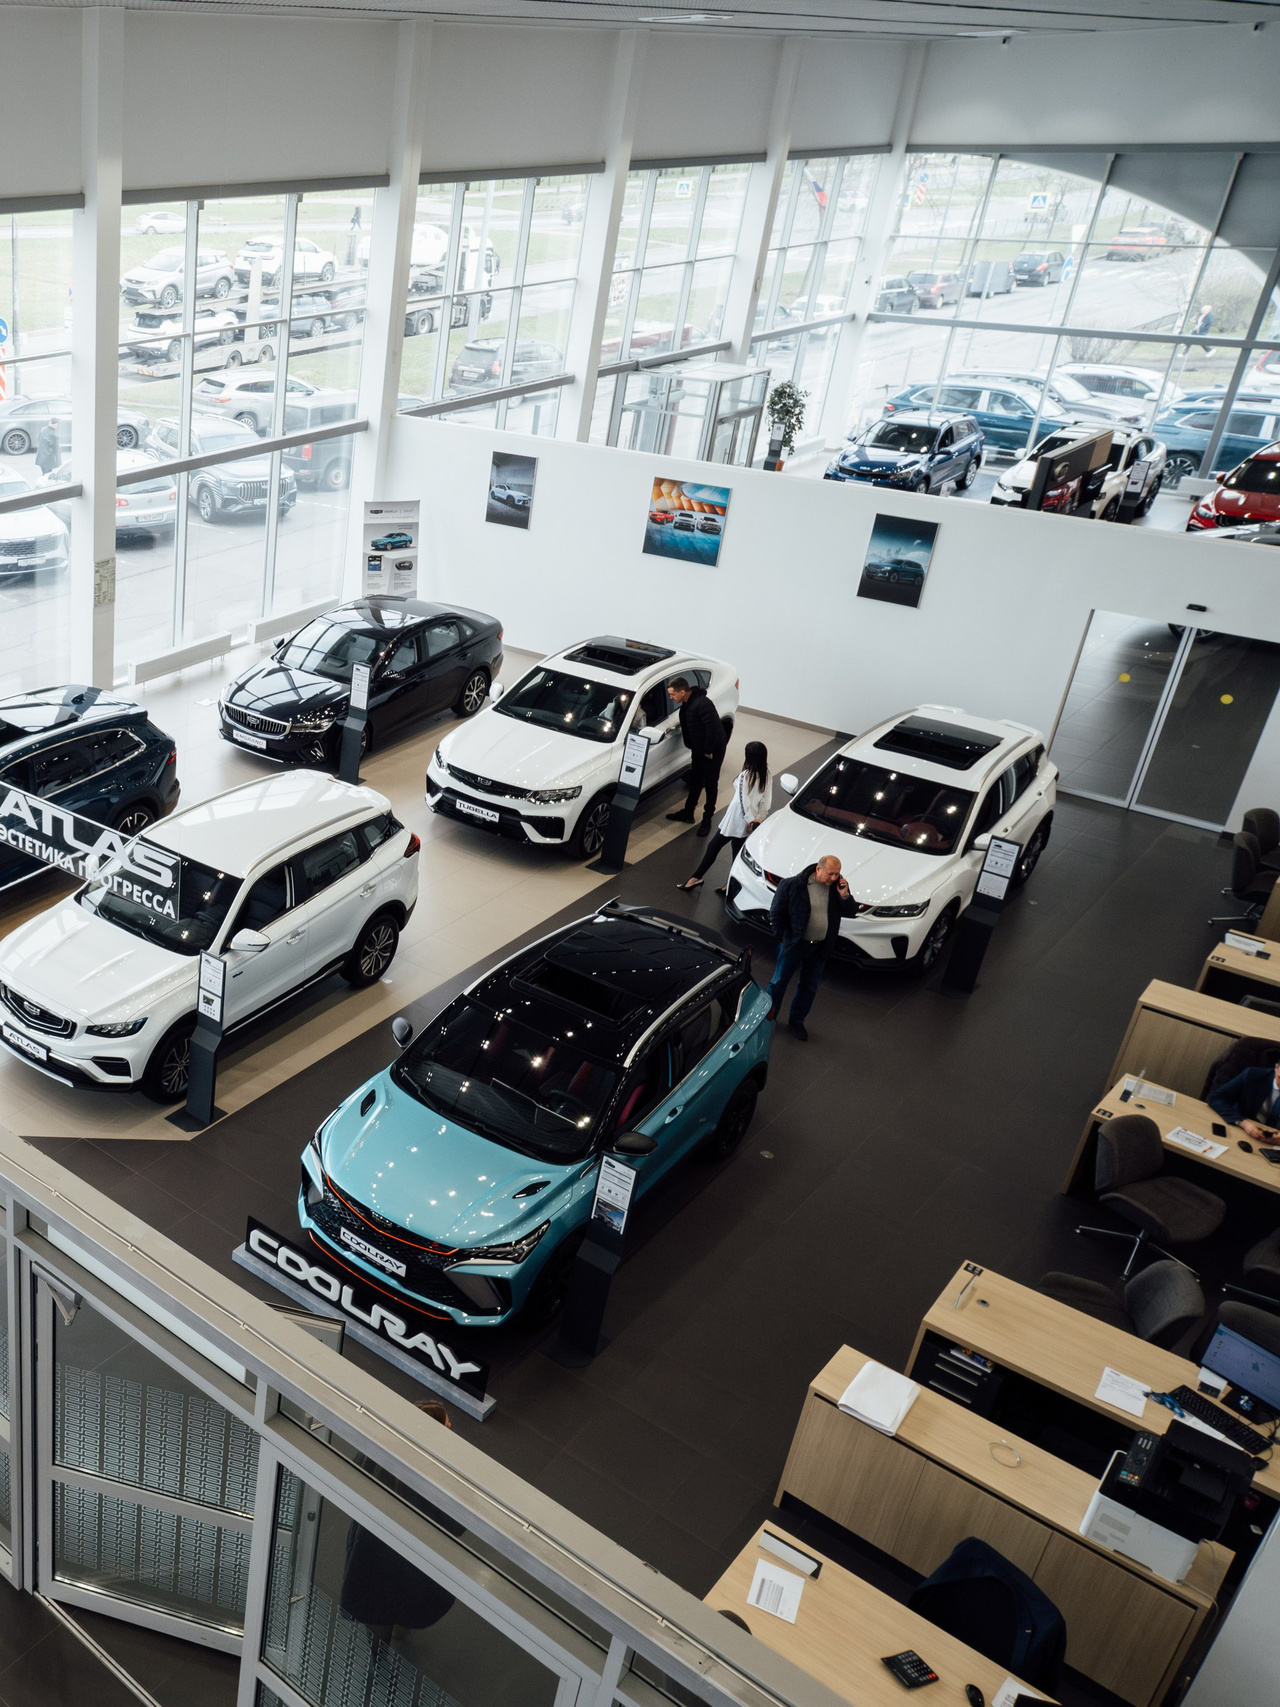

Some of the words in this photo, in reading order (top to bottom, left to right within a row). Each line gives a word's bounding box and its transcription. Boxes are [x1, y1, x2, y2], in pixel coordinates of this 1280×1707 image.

[236, 732, 263, 746] EMGRAND
[458, 801, 498, 820] TUGELLA
[9, 1032, 41, 1054] ATLAS
[342, 1231, 404, 1270] COOLRAY
[249, 1228, 482, 1380] COOLRAY
